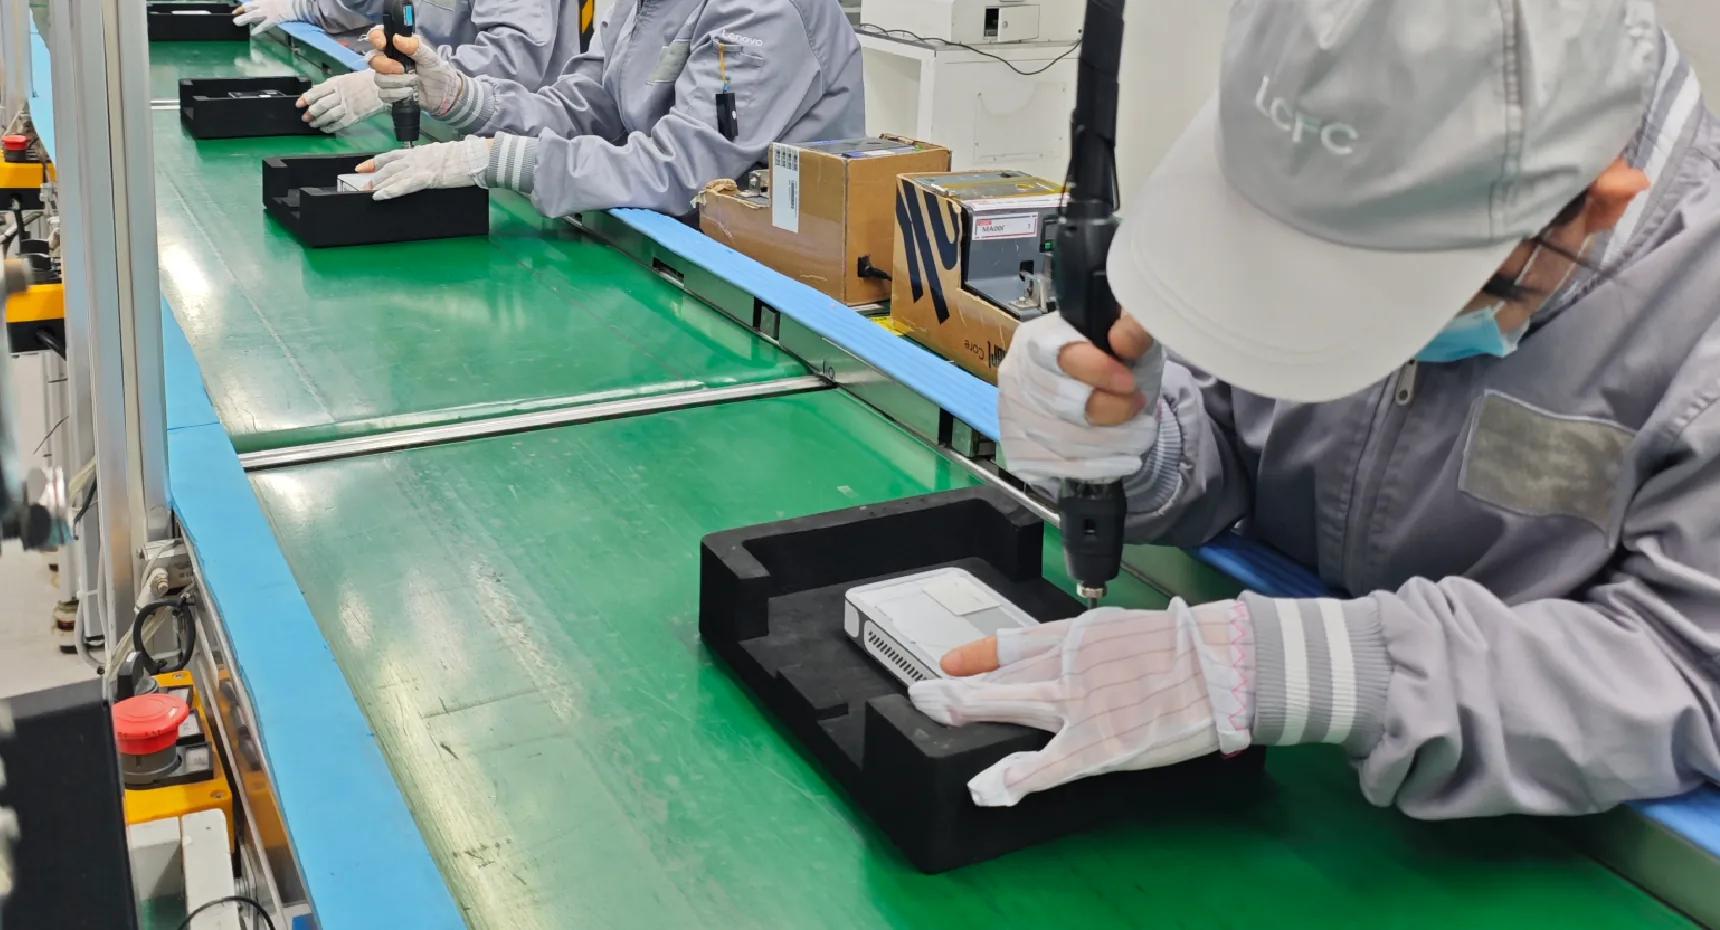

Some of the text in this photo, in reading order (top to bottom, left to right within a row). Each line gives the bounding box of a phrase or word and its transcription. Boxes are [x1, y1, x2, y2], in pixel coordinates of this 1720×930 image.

[722, 29, 763, 47] Lenovo
[1255, 75, 1359, 154] LCFC
[964, 339, 985, 360] Core
